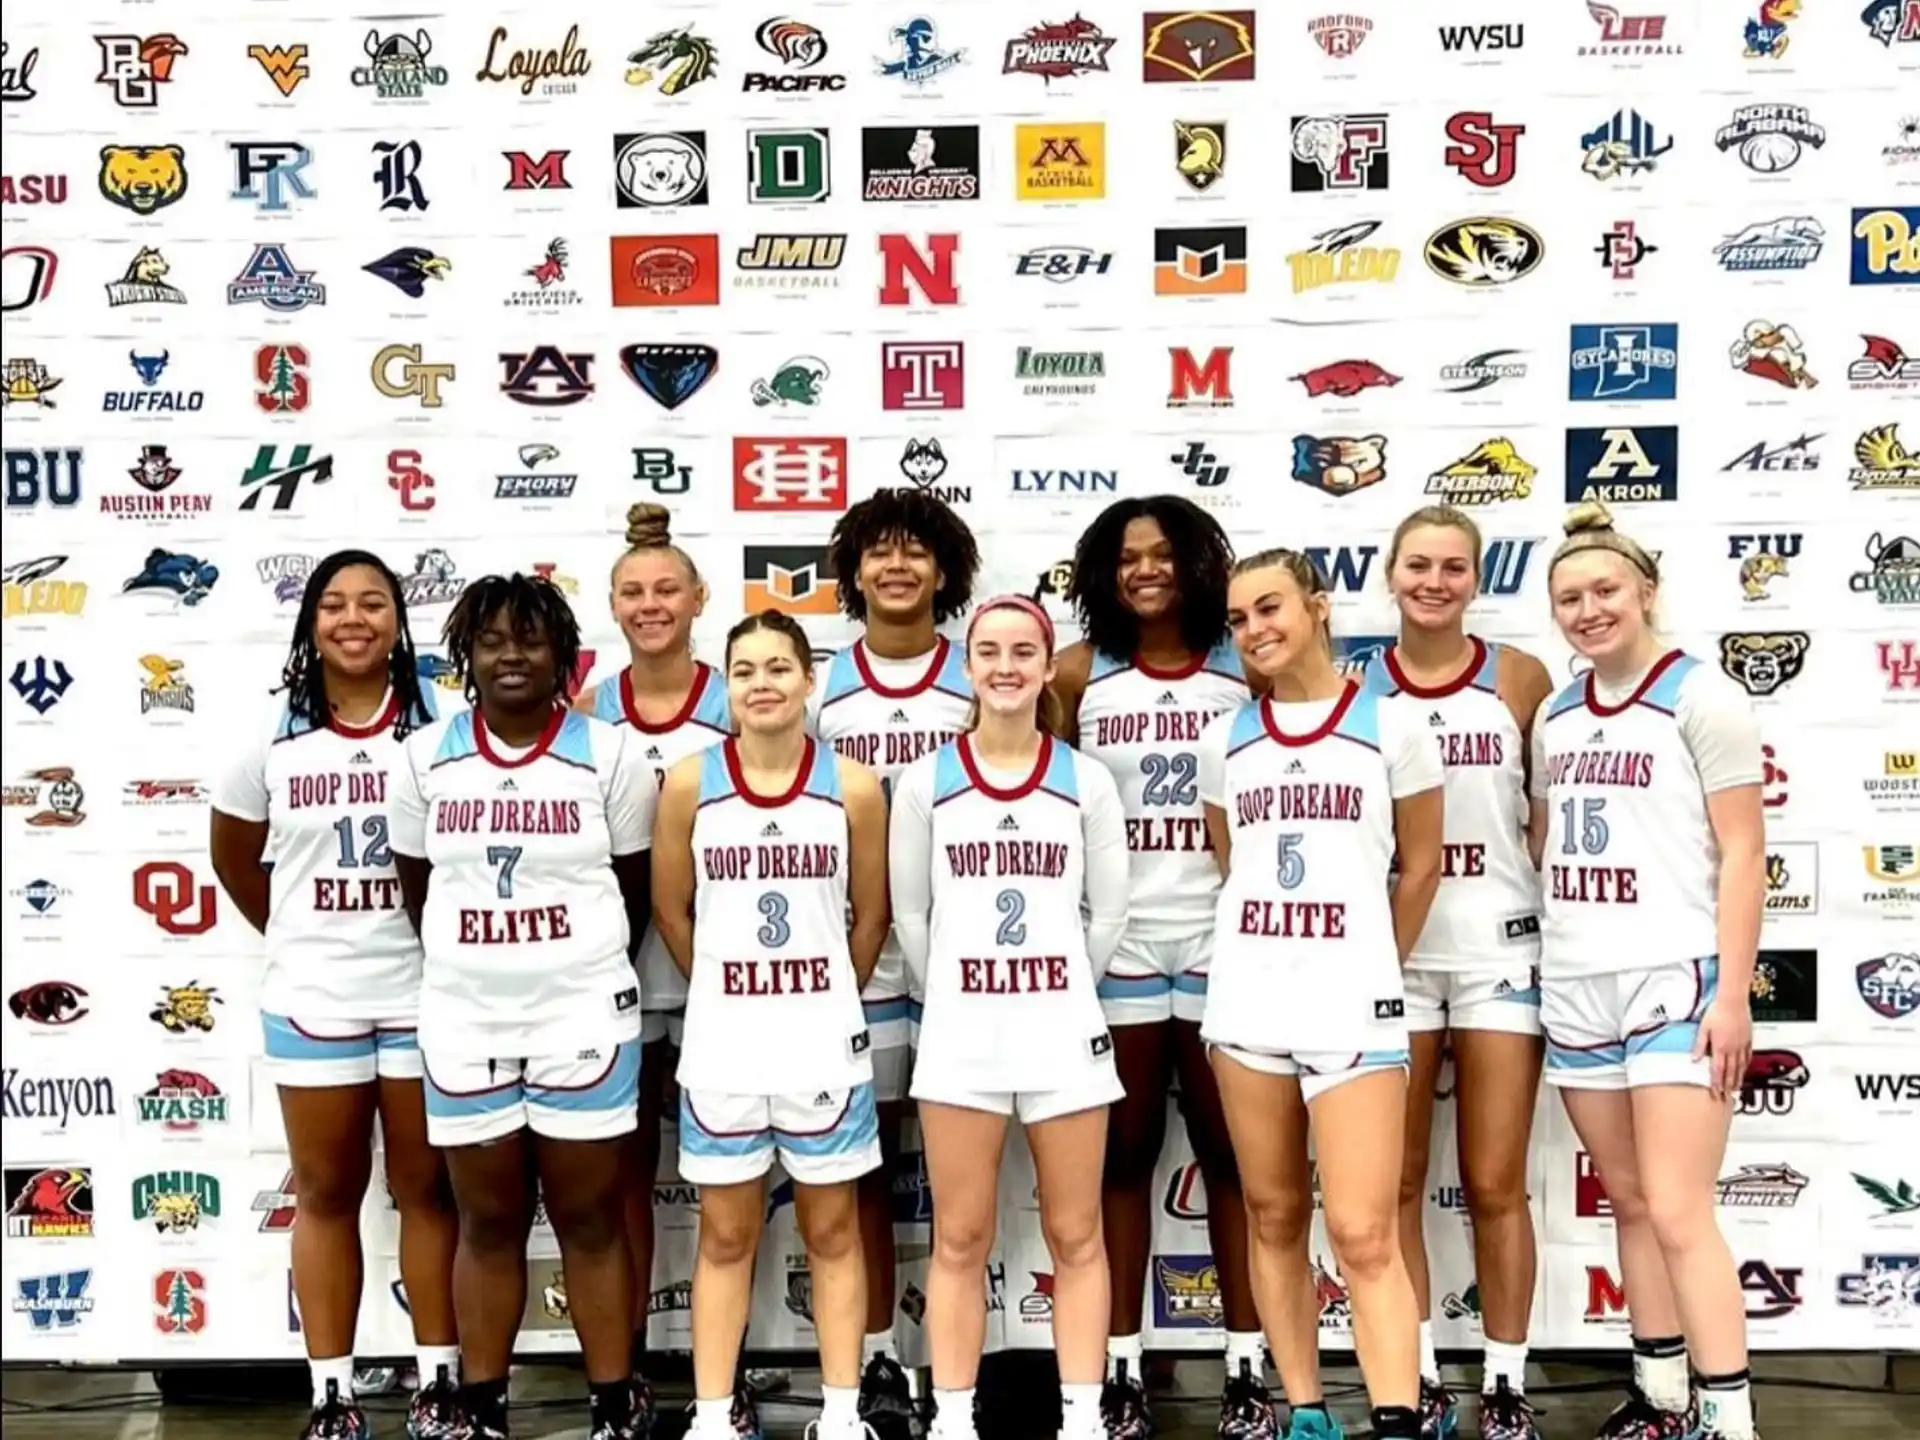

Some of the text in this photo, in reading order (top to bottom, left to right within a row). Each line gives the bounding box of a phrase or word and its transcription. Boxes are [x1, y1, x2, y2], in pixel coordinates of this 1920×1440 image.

[1307, 14, 1374, 32] RADFORD
[1439, 24, 1524, 52] WVSU
[1600, 15, 1667, 41] LEE
[476, 23, 592, 96] Loyola
[1009, 41, 1105, 66] PHOENIX
[1, 42, 39, 101] al
[350, 65, 449, 86] CLEVELAND
[742, 72, 848, 93] PACIFIC
[376, 83, 424, 98] STATE
[1718, 117, 1826, 144] ALABAMA
[1733, 104, 1809, 122] NORTH
[752, 131, 829, 200] D
[1444, 112, 1526, 187] SJ
[501, 150, 574, 190] M
[865, 176, 978, 198] KNIGHTS
[2, 175, 68, 204] ASU
[737, 234, 847, 270] JMU
[878, 233, 962, 305] N
[1015, 252, 1114, 277] E&H
[1285, 245, 1403, 294] TOLEDO
[1722, 243, 1822, 264] ASSUMPTION
[230, 286, 321, 299] AMERICAN
[1015, 347, 1106, 378] LOYOLA
[1168, 347, 1234, 399] M
[1440, 365, 1527, 379] STEVENSON
[1573, 348, 1677, 368] SYCAMORES
[1848, 360, 1920, 381] SVS
[371, 344, 456, 408] GT
[103, 391, 204, 413] BUFFALO
[632, 447, 693, 494] BU
[1590, 429, 1660, 478] A
[1719, 440, 1823, 473] ACES
[3, 447, 84, 507] BU
[499, 476, 573, 492] EMORY
[1012, 470, 1119, 492] LYNN
[1426, 473, 1516, 494] EMERSON
[1581, 484, 1663, 502] AKRON
[100, 493, 212, 513] AUSTIN PEAY
[1727, 534, 1803, 559] FIU
[1849, 570, 1920, 592] CLEVELA
[1876, 589, 1920, 606] STAT
[2, 580, 88, 619] LEDO
[140, 686, 195, 715] CANISIUS
[1097, 710, 1225, 747] HOOP DREA
[885, 732, 957, 764] DREAM
[1437, 733, 1505, 766] REAMS
[1140, 752, 1199, 806] 22
[1573, 750, 1655, 788] DREAMS
[1863, 778, 1919, 792] WOOST
[288, 774, 342, 809] HOOP
[1279, 783, 1364, 822] DREAMS
[436, 799, 582, 834] HOOP DREAMS
[1560, 797, 1611, 856] 15
[334, 815, 393, 869] 12
[994, 841, 1069, 878] DREAMS
[486, 846, 524, 899] 7
[703, 843, 840, 881] HOOP DREAMS
[1276, 832, 1306, 889] 5
[132, 861, 217, 935] OU
[313, 877, 399, 912] ELIT
[1551, 866, 1639, 904] ELITE
[457, 904, 572, 944] ELITE
[757, 890, 791, 949] 3
[995, 888, 1028, 946] 2
[1238, 900, 1347, 939] ELITE
[722, 956, 832, 996] ELITE
[960, 956, 1070, 994] ELITE
[2, 1067, 117, 1129] Kenyon
[1855, 1073, 1920, 1101] WVS
[138, 1097, 228, 1122] WASH
[131, 1170, 222, 1222] OHIO
[12, 1297, 96, 1315] WASHBURN
